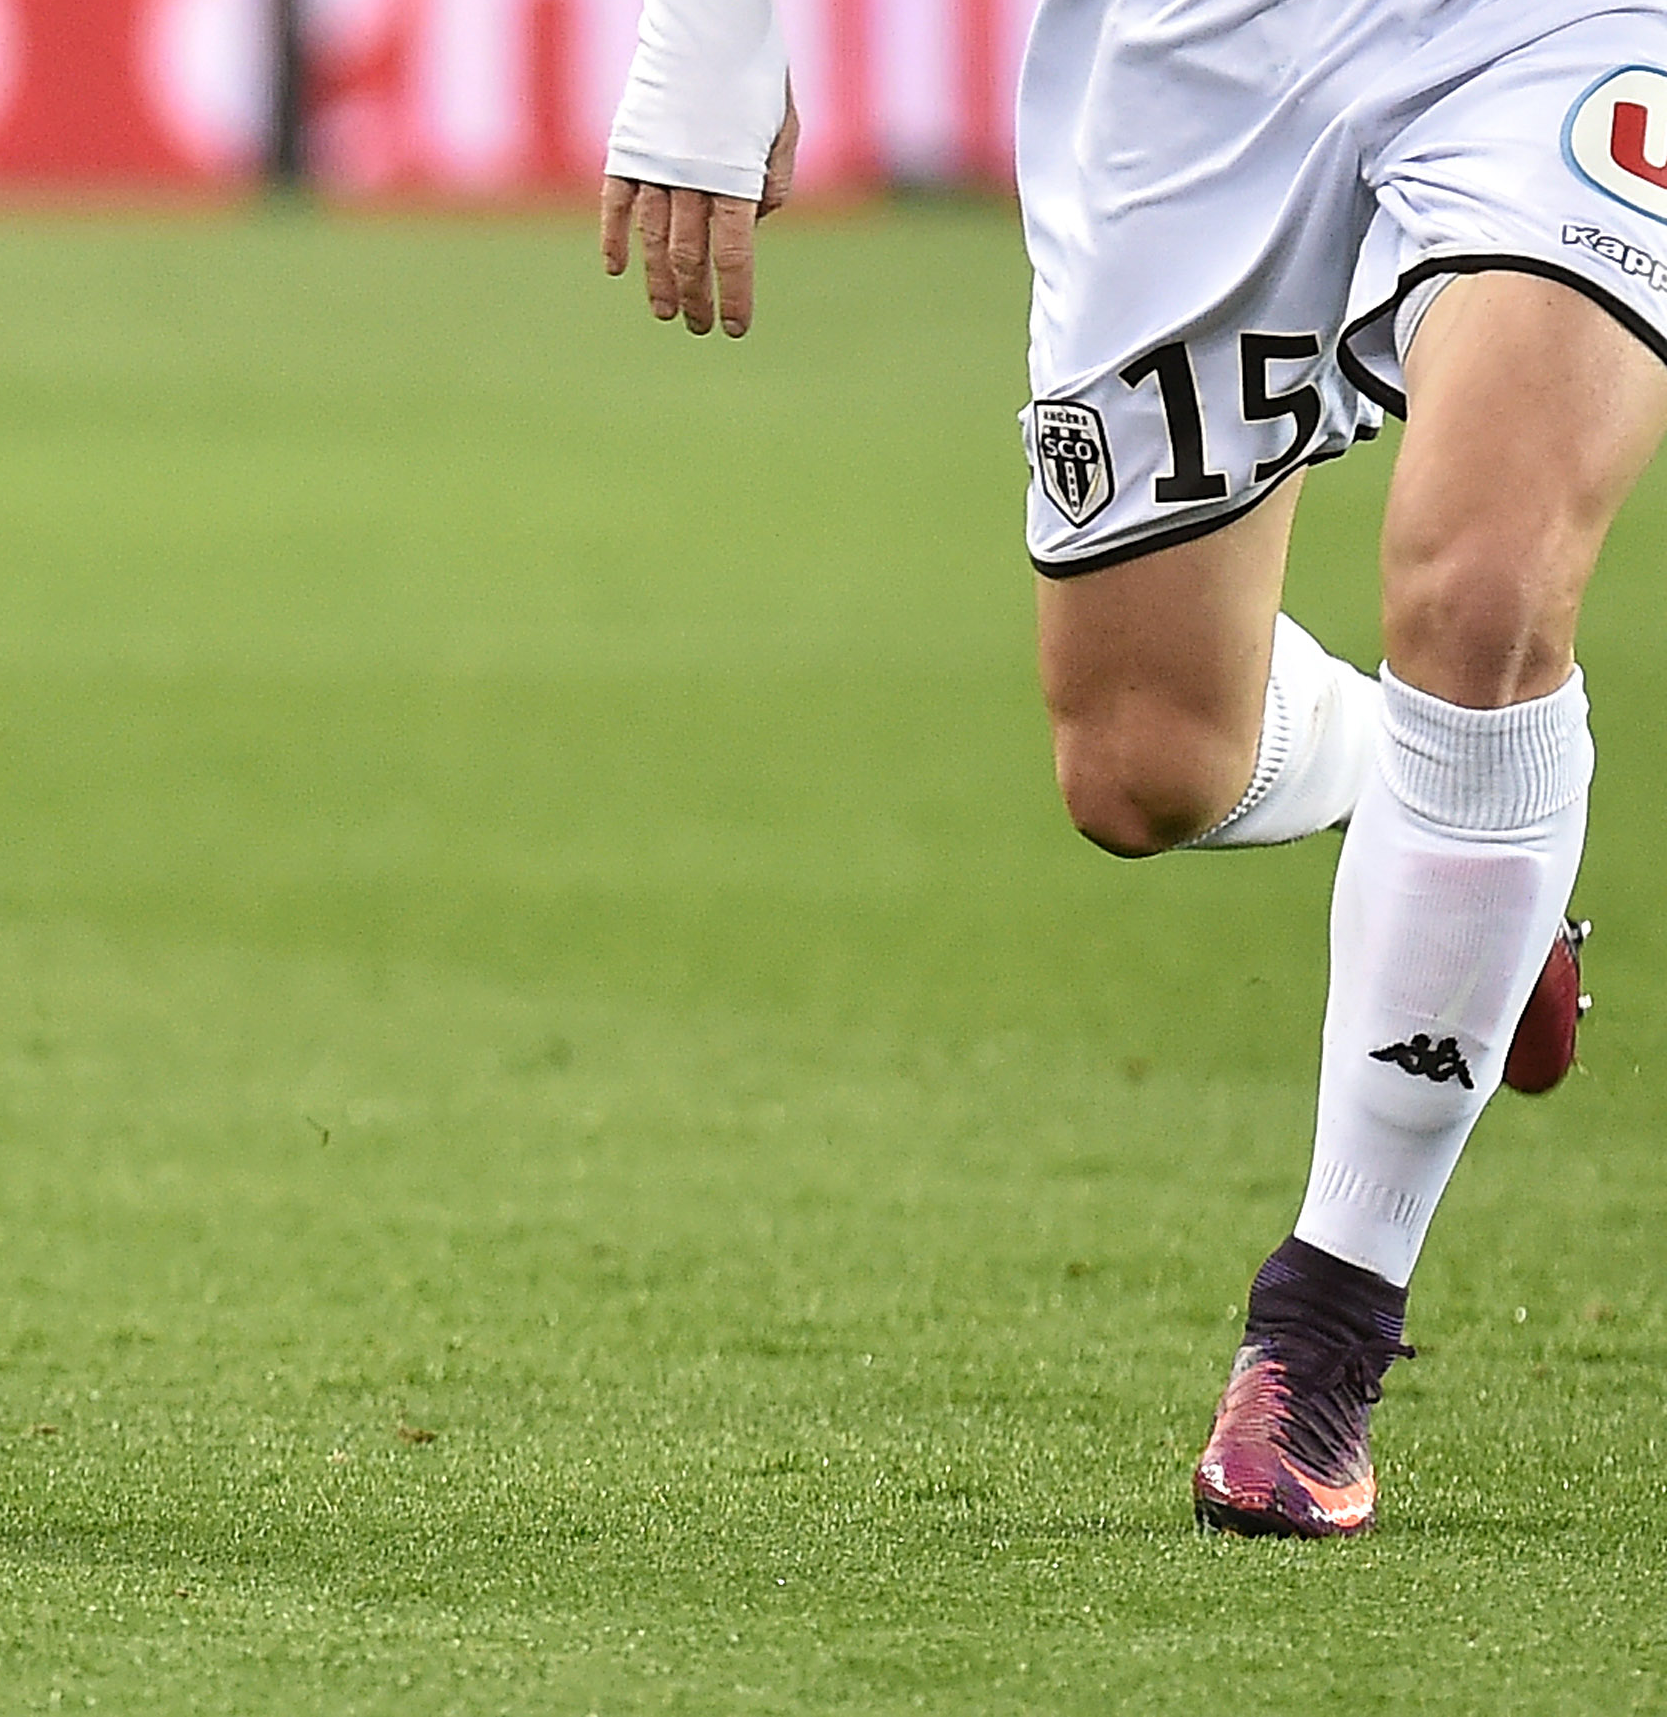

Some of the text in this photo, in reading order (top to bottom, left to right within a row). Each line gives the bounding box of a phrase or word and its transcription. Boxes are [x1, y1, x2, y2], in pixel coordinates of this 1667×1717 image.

[1562, 224, 1667, 292] Kapp
[1043, 437, 1093, 461] SCO
[1118, 331, 1325, 505] 15
